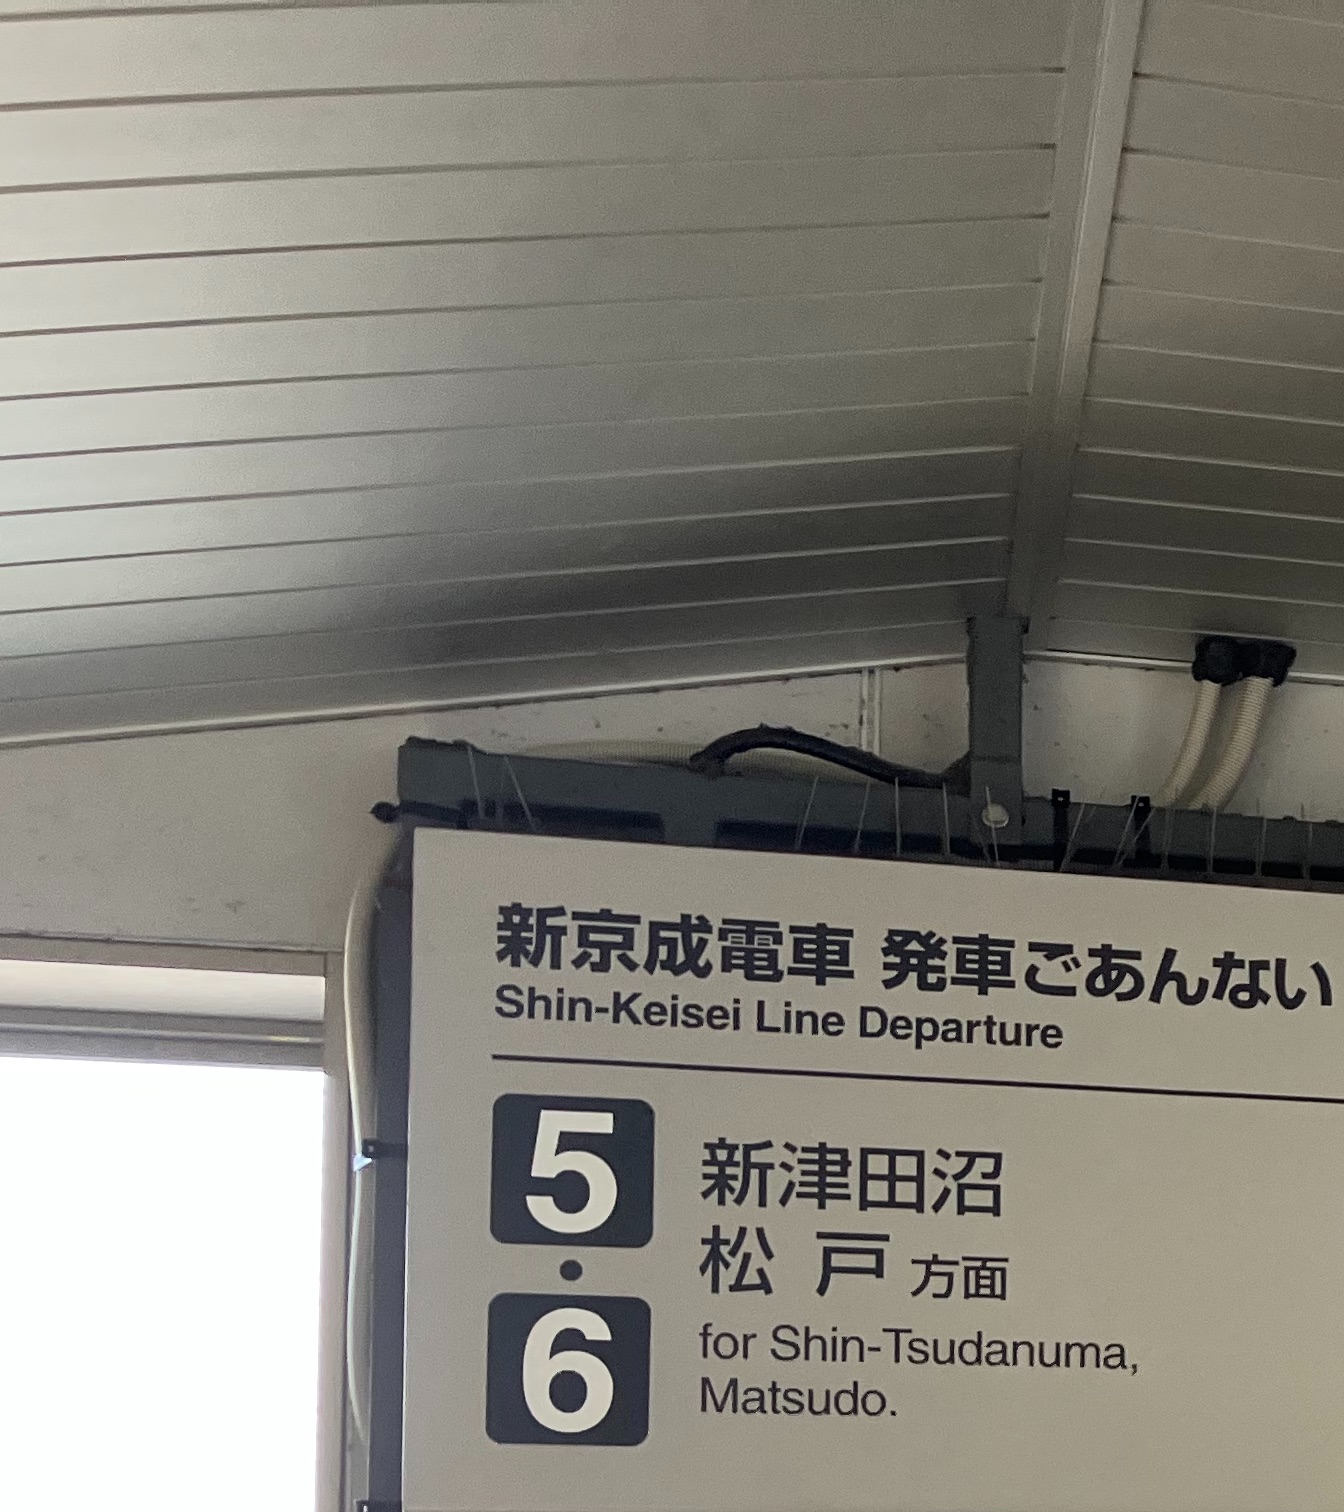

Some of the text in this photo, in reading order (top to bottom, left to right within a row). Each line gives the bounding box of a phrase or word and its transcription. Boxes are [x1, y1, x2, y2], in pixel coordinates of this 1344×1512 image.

[497, 902, 1335, 1011] 新京成電車 発車ごあんない
[495, 984, 1064, 1051] Shin-Keisei Line Departure
[525, 1108, 618, 1235] 5
[699, 1137, 1004, 1219] 新津田沼
[909, 1253, 1009, 1302] 方面
[521, 1307, 616, 1434] 6
[699, 1326, 1140, 1377] for Shin-Tsudanuma,
[699, 1377, 898, 1420] Matsudo.
